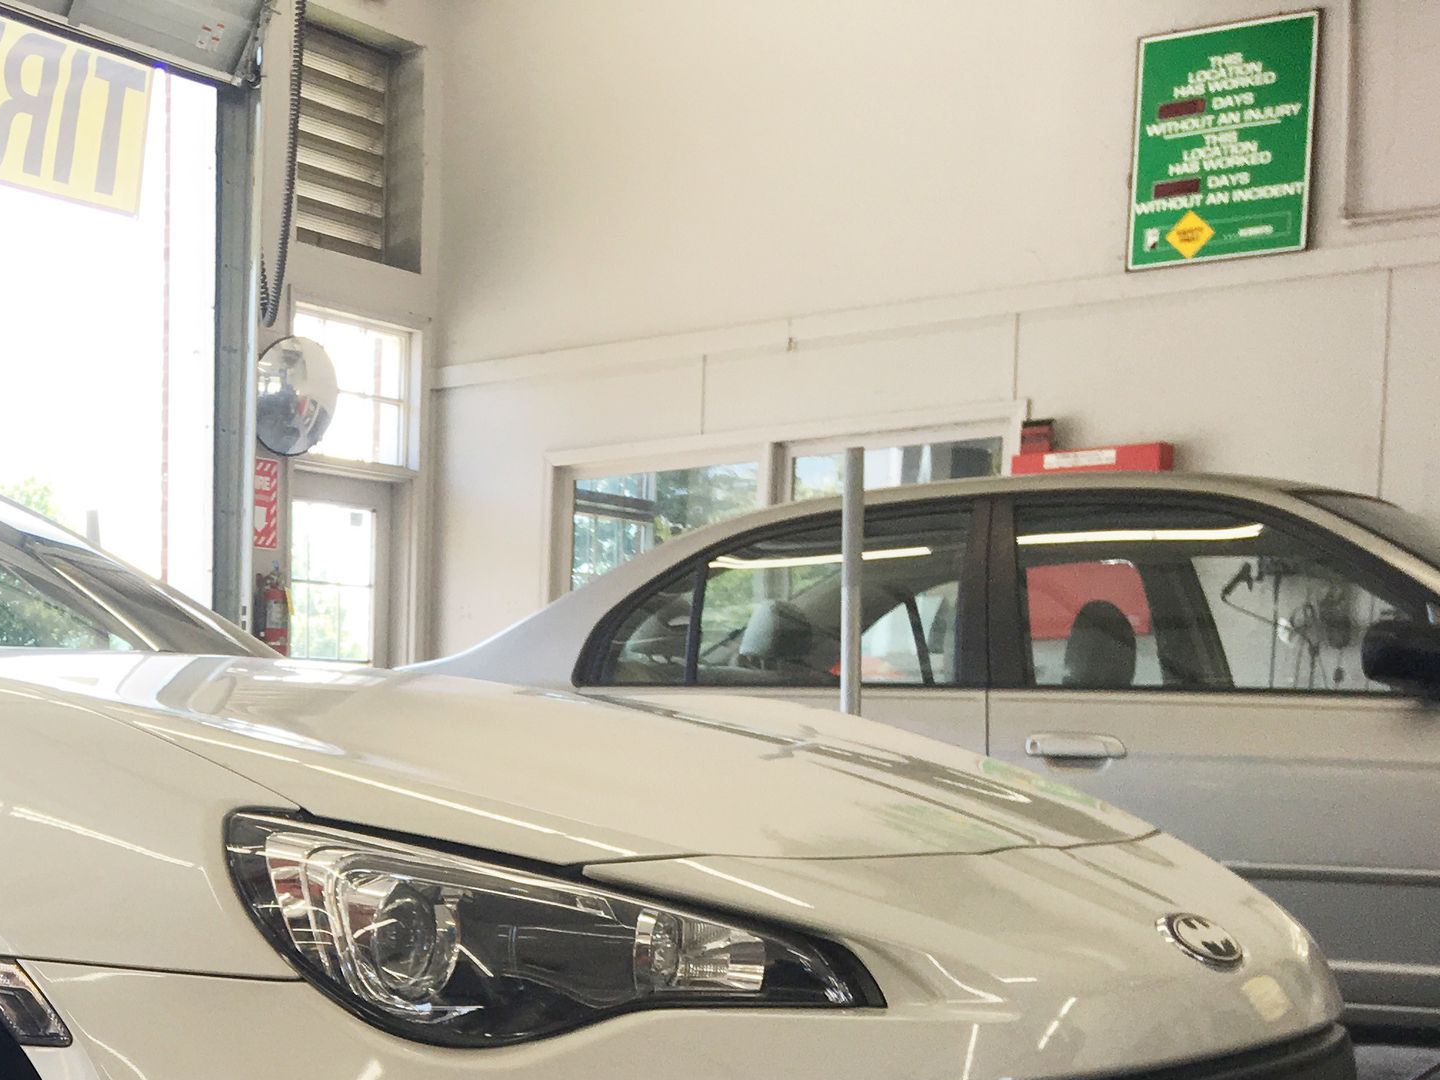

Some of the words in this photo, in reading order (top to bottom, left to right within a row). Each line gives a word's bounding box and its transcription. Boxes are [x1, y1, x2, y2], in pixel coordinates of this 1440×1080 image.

[1209, 52, 1242, 69] THIS
[1189, 61, 1262, 83] LOCATION
[1174, 84, 1205, 97] HAS
[1207, 72, 1276, 91] WORKED
[1213, 92, 1254, 109] DAYS
[1147, 115, 1214, 135] WITHOUT
[1217, 111, 1240, 125] AN
[1244, 102, 1302, 119] INJURY
[1204, 131, 1237, 146] THIS
[1184, 140, 1257, 162] LOCATION
[1169, 160, 1199, 175] HAS
[1204, 150, 1272, 170] WORKED
[1207, 171, 1250, 188] DAYS
[1136, 194, 1203, 215] WITHOUT
[1206, 191, 1229, 205] AN
[1233, 181, 1304, 202] INCIDENT
